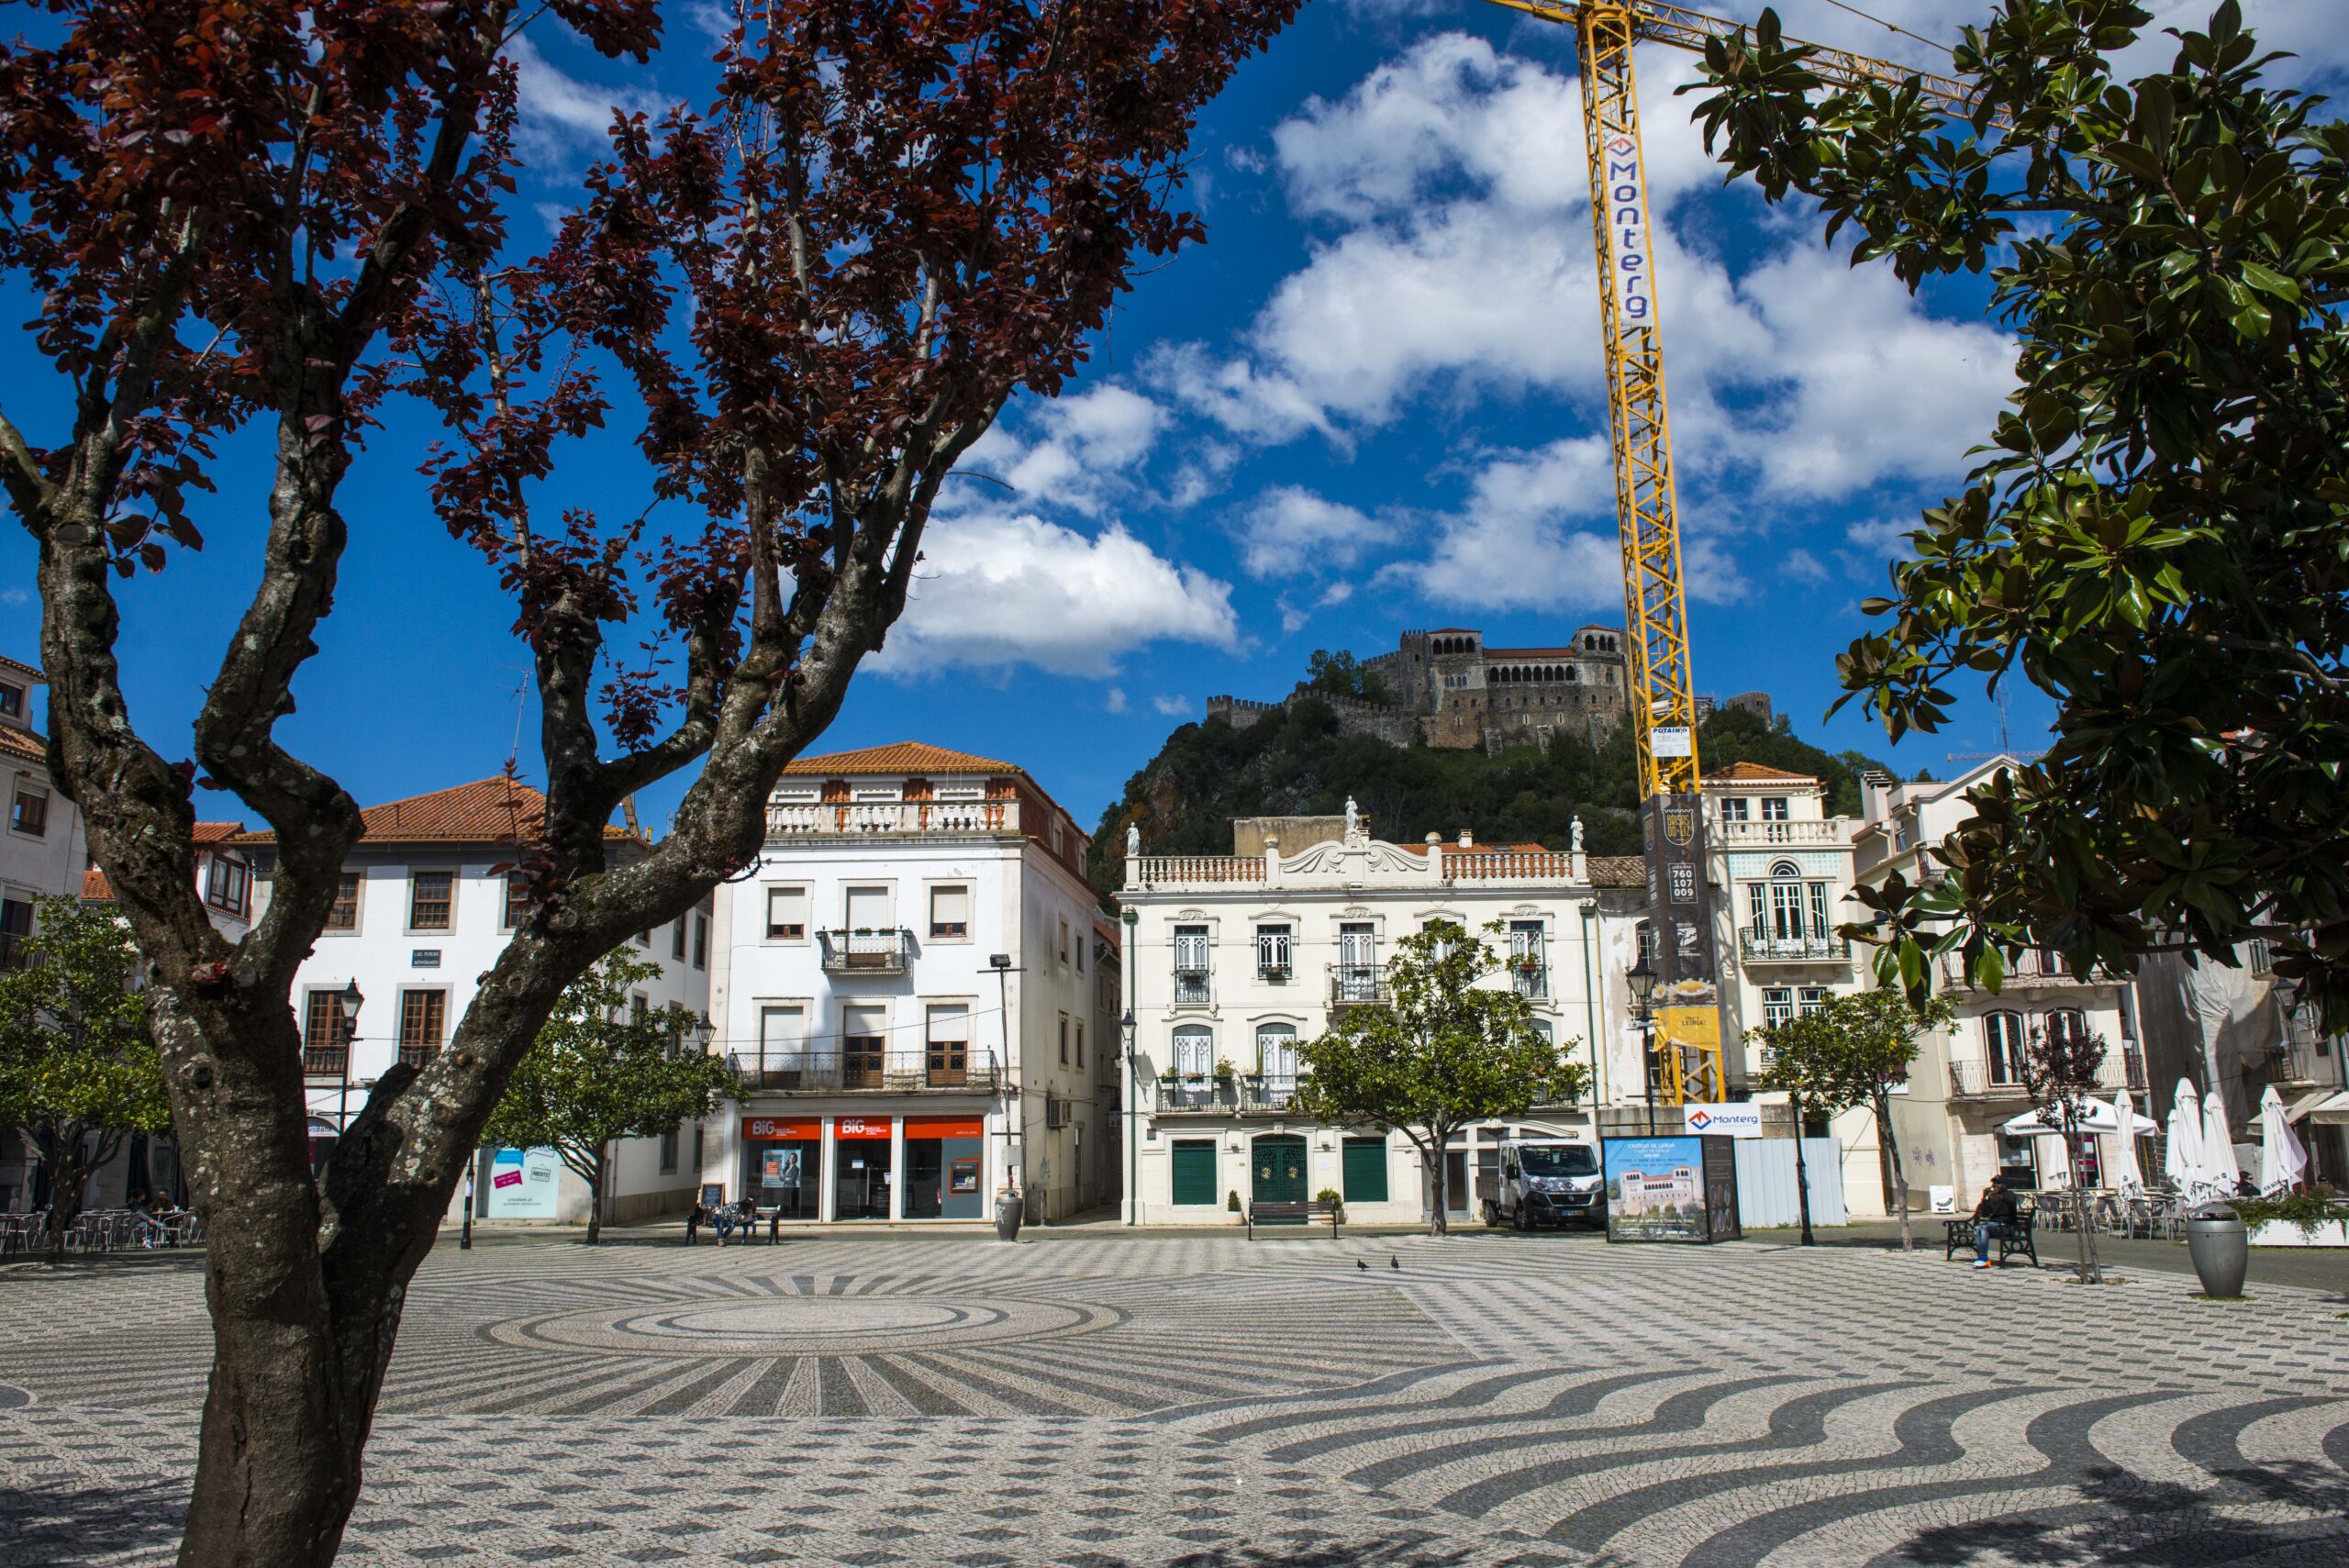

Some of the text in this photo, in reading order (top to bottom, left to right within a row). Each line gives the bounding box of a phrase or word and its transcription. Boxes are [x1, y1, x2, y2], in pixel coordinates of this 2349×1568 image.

[1609, 161, 1648, 319] Monterg
[1666, 814, 1690, 827] BRISAS
[1673, 870, 1693, 878] 760
[1674, 879, 1693, 887] 107
[1674, 888, 1694, 896] 009
[842, 1118, 865, 1134] BiG
[1713, 1116, 1758, 1125] Monterg
[752, 1119, 775, 1135] BiG
